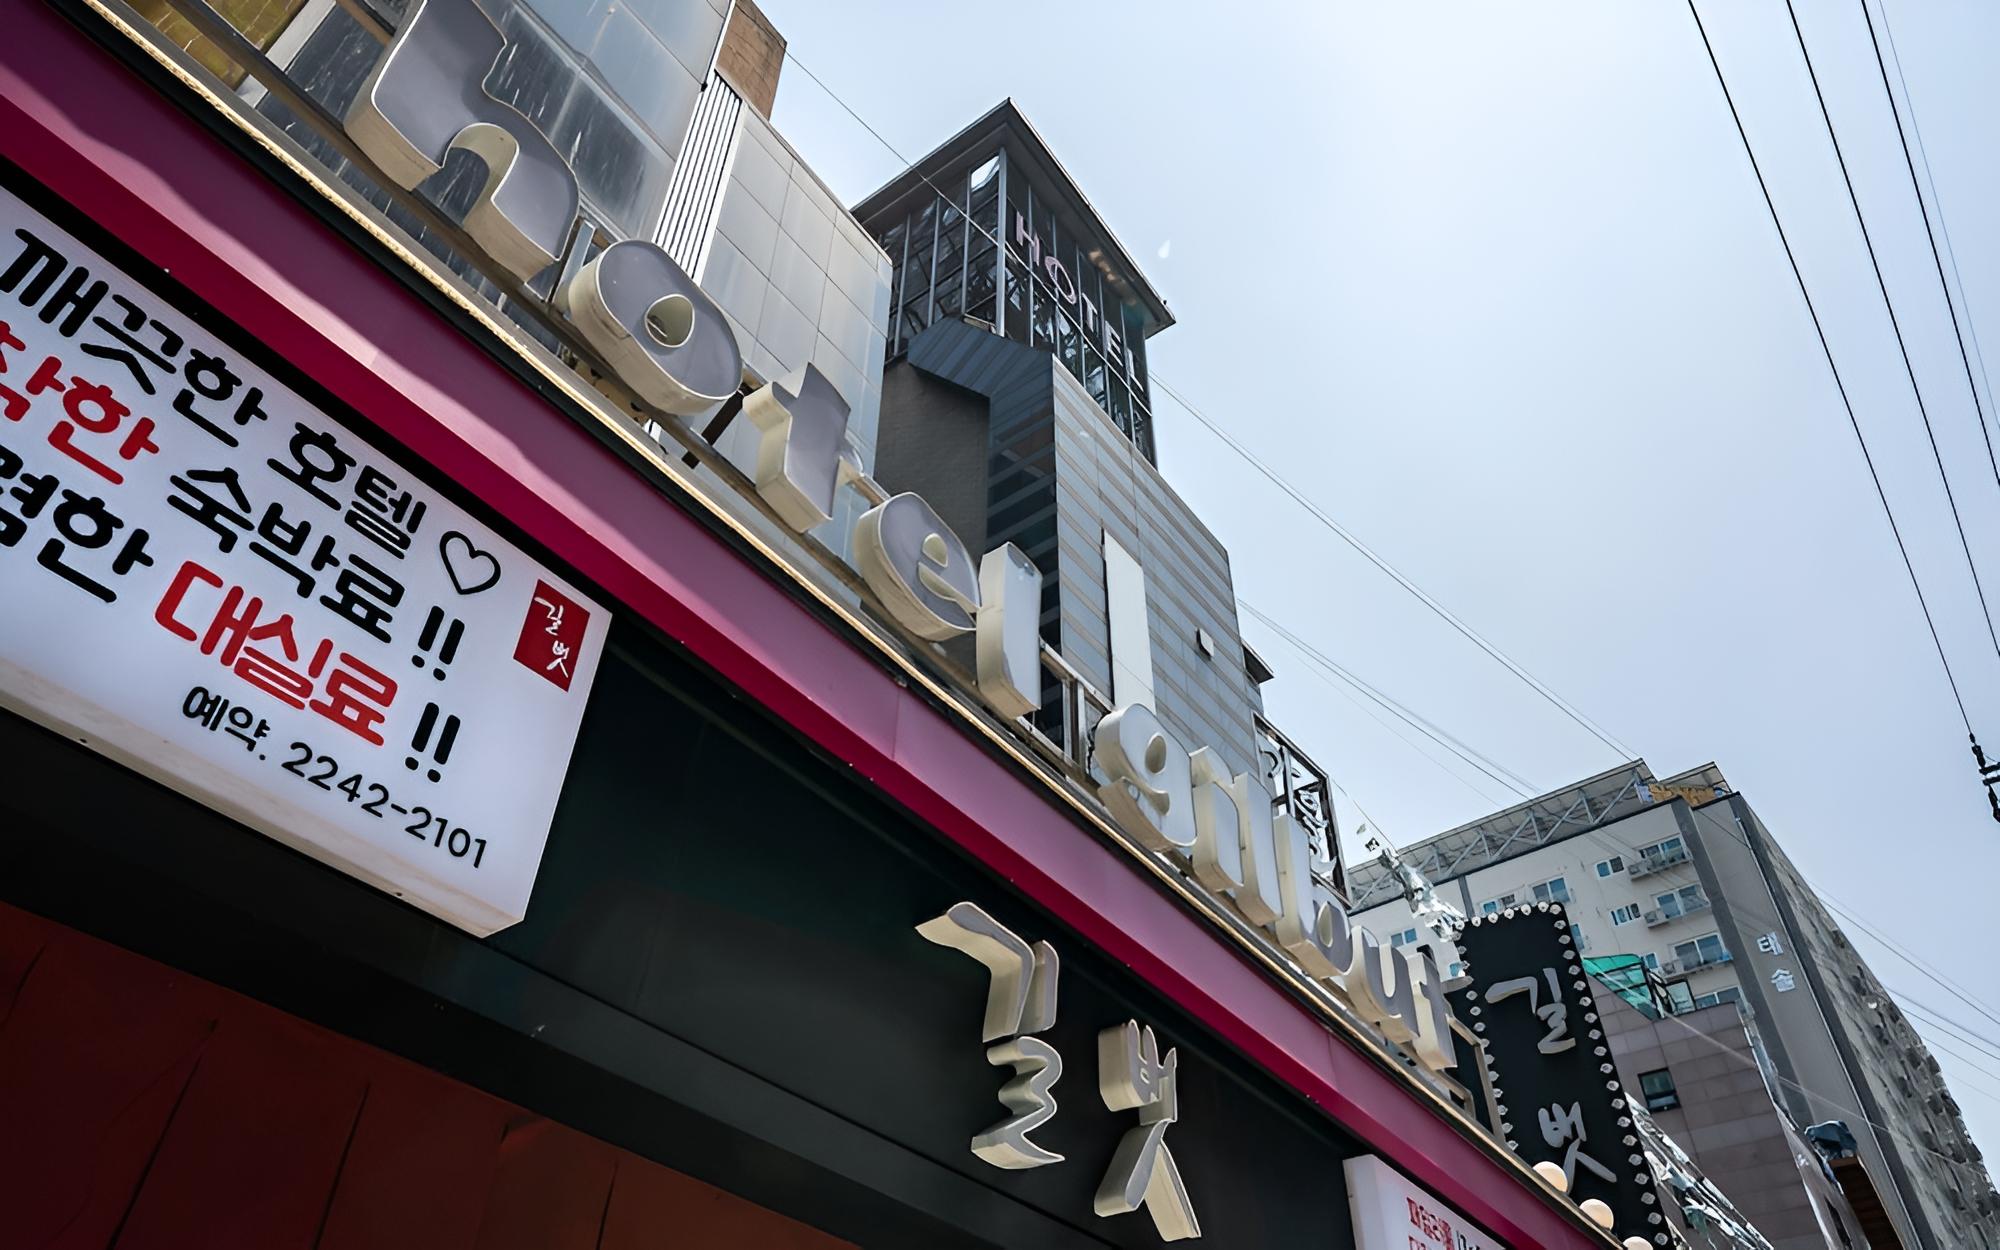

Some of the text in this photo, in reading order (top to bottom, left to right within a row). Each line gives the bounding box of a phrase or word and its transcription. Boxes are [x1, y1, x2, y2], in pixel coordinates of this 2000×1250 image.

[1, 227, 427, 560] 깨끗한 호텔
[343, 0, 1042, 718] hotel
[1015, 209, 1145, 394] HOTEL
[154, 560, 399, 747] 대실료
[167, 466, 406, 644] 숙박료
[281, 741, 488, 869] 2242-2101
[914, 900, 1202, 1243] 길벗
[1485, 967, 1618, 1196] 길벗
